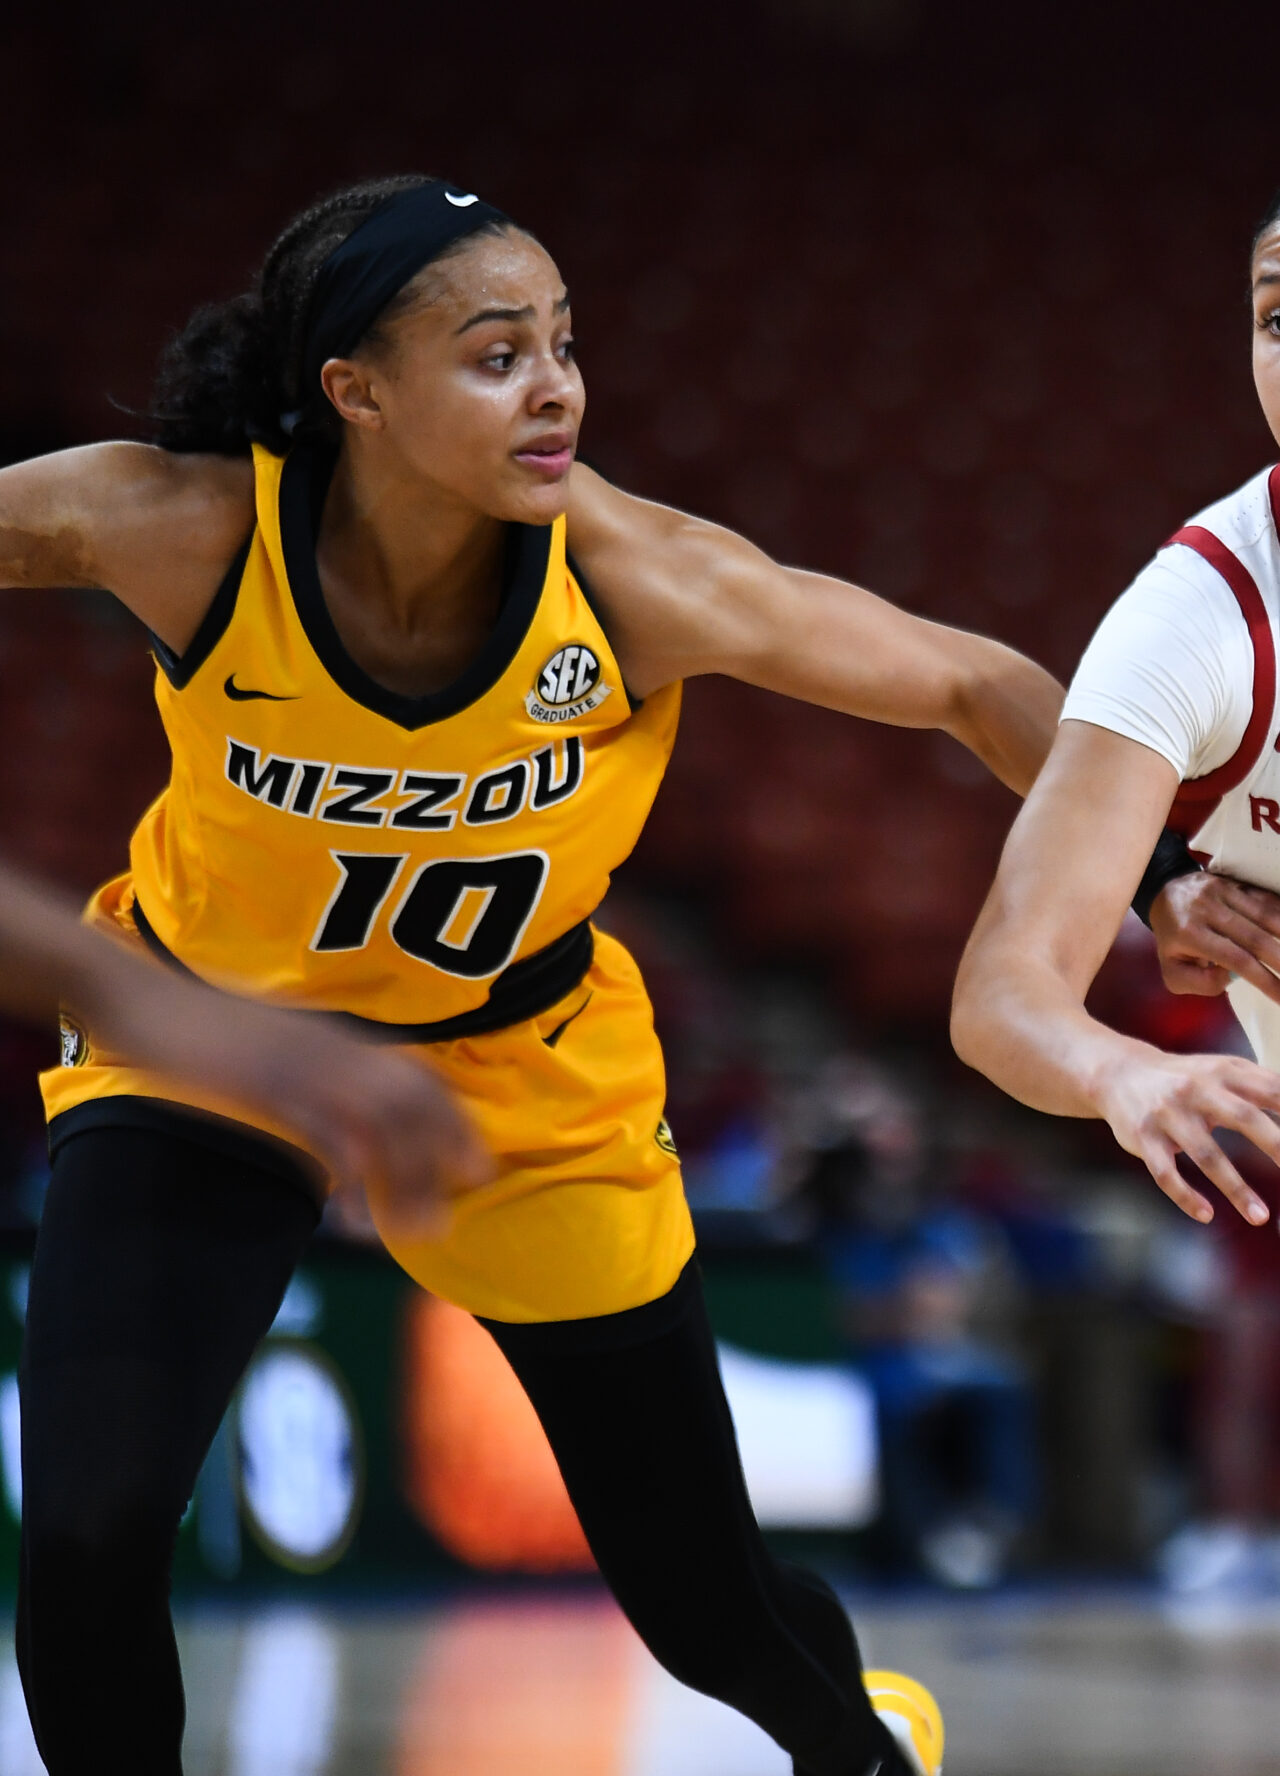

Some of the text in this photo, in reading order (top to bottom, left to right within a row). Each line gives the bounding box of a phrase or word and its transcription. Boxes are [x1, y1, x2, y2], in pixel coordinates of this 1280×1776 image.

[530, 697, 597, 722] GRADUATE
[540, 646, 598, 704] SEC
[224, 735, 586, 831] MIZZOU
[307, 847, 550, 980] 10
